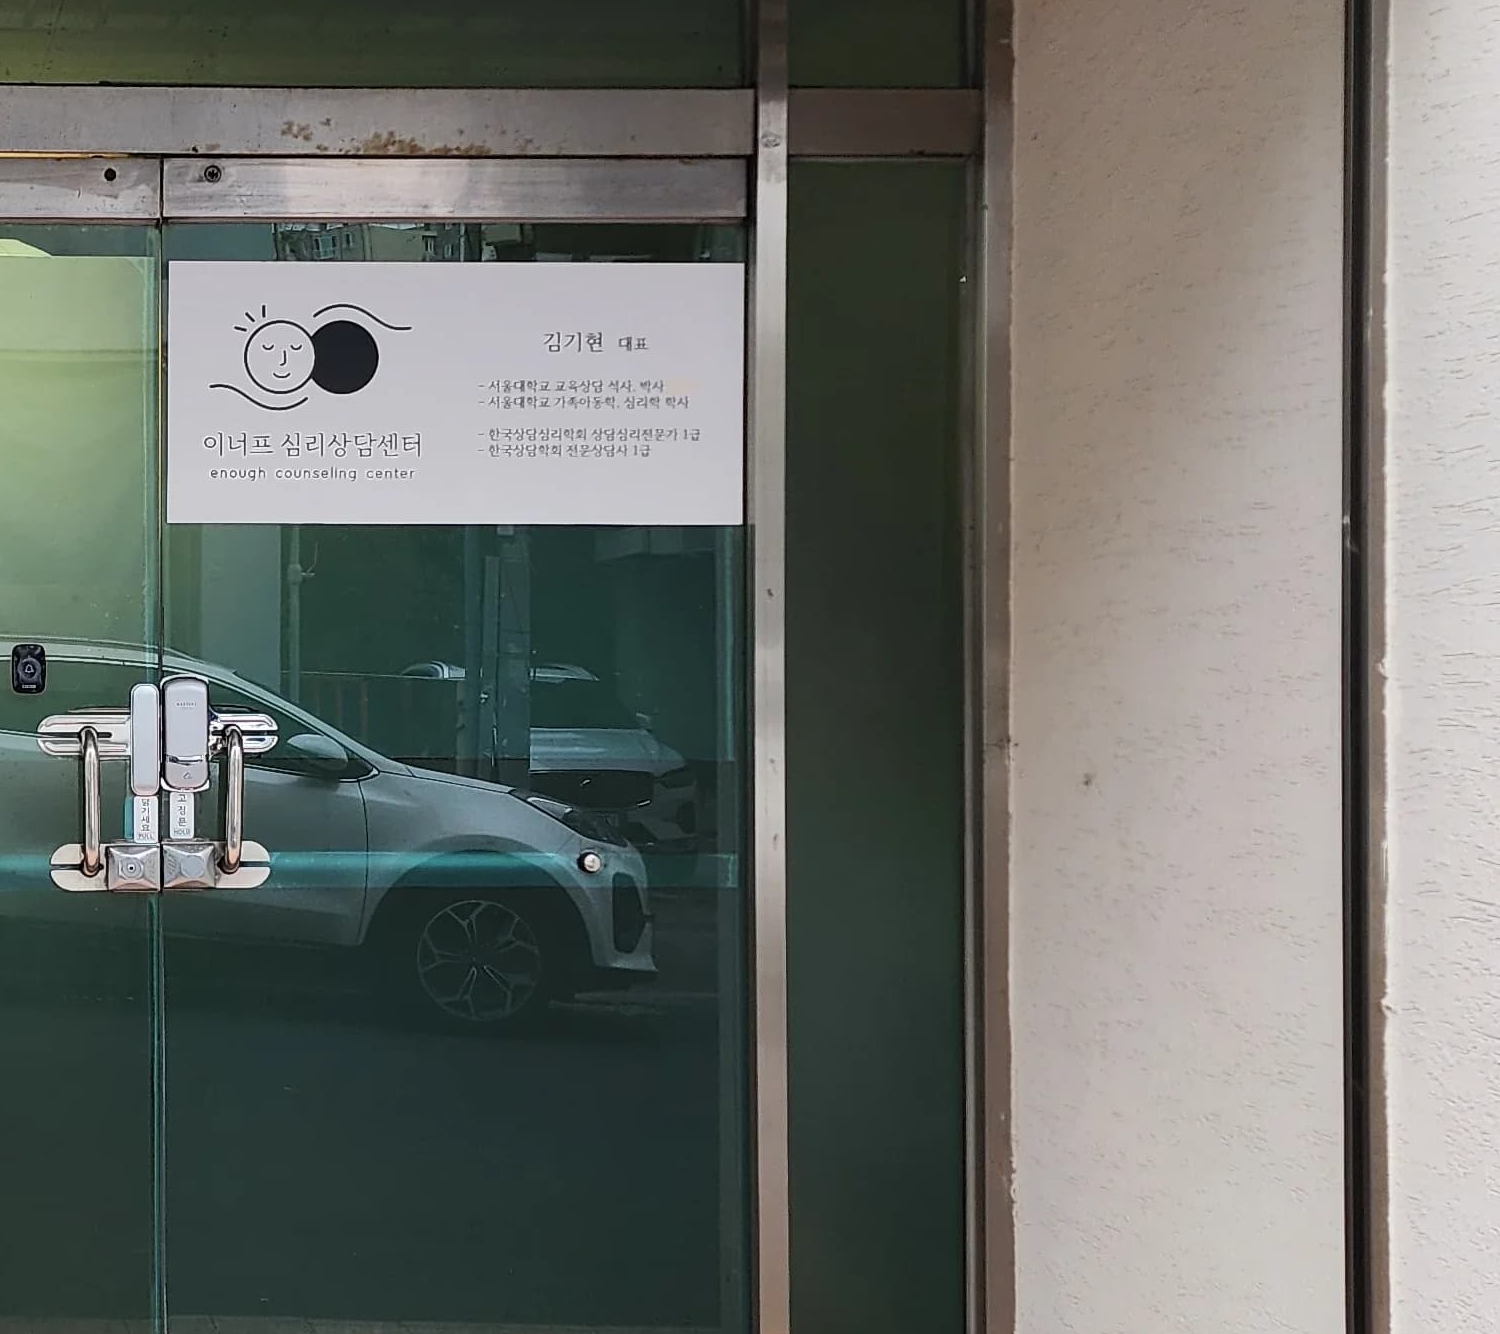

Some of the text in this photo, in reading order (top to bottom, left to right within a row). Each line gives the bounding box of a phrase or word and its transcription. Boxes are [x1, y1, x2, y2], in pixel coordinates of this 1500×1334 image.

[543, 331, 649, 353] 김기현 대표
[488, 380, 551, 394] 서울대학교
[555, 380, 604, 394] 교육상담
[488, 396, 551, 410] 서울대학교
[624, 396, 661, 410] 심리학
[488, 427, 701, 442] 한국상담심리학회 상담심리전문가 1급
[203, 431, 422, 458] 이너프 심리상담센터
[488, 443, 651, 458] 한국상담학회 전문상담사 1급
[210, 466, 415, 482] enough counseling center
